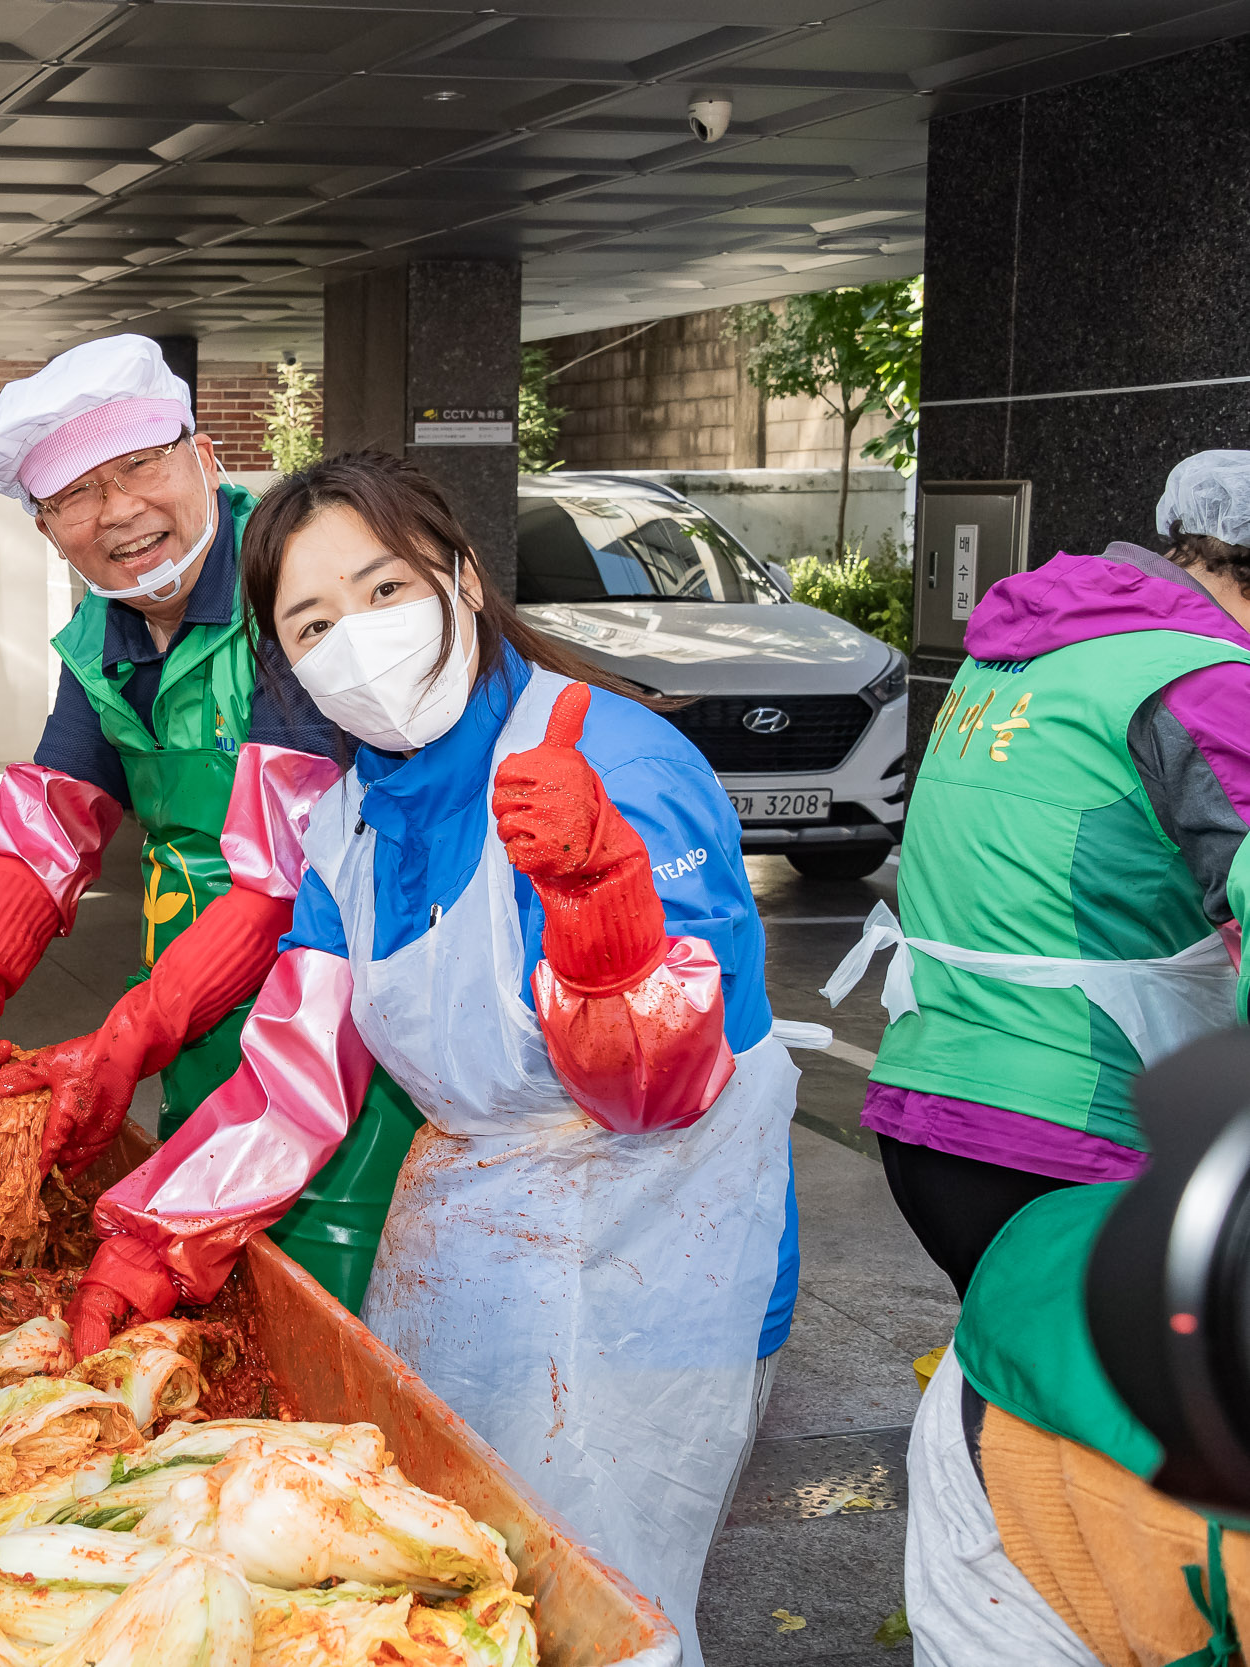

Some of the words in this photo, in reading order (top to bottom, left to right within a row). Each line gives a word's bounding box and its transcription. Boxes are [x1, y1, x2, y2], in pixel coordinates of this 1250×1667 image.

[443, 410, 474, 420] CCTV
[957, 536, 970, 609] 배수관
[764, 794, 819, 816] 3208
